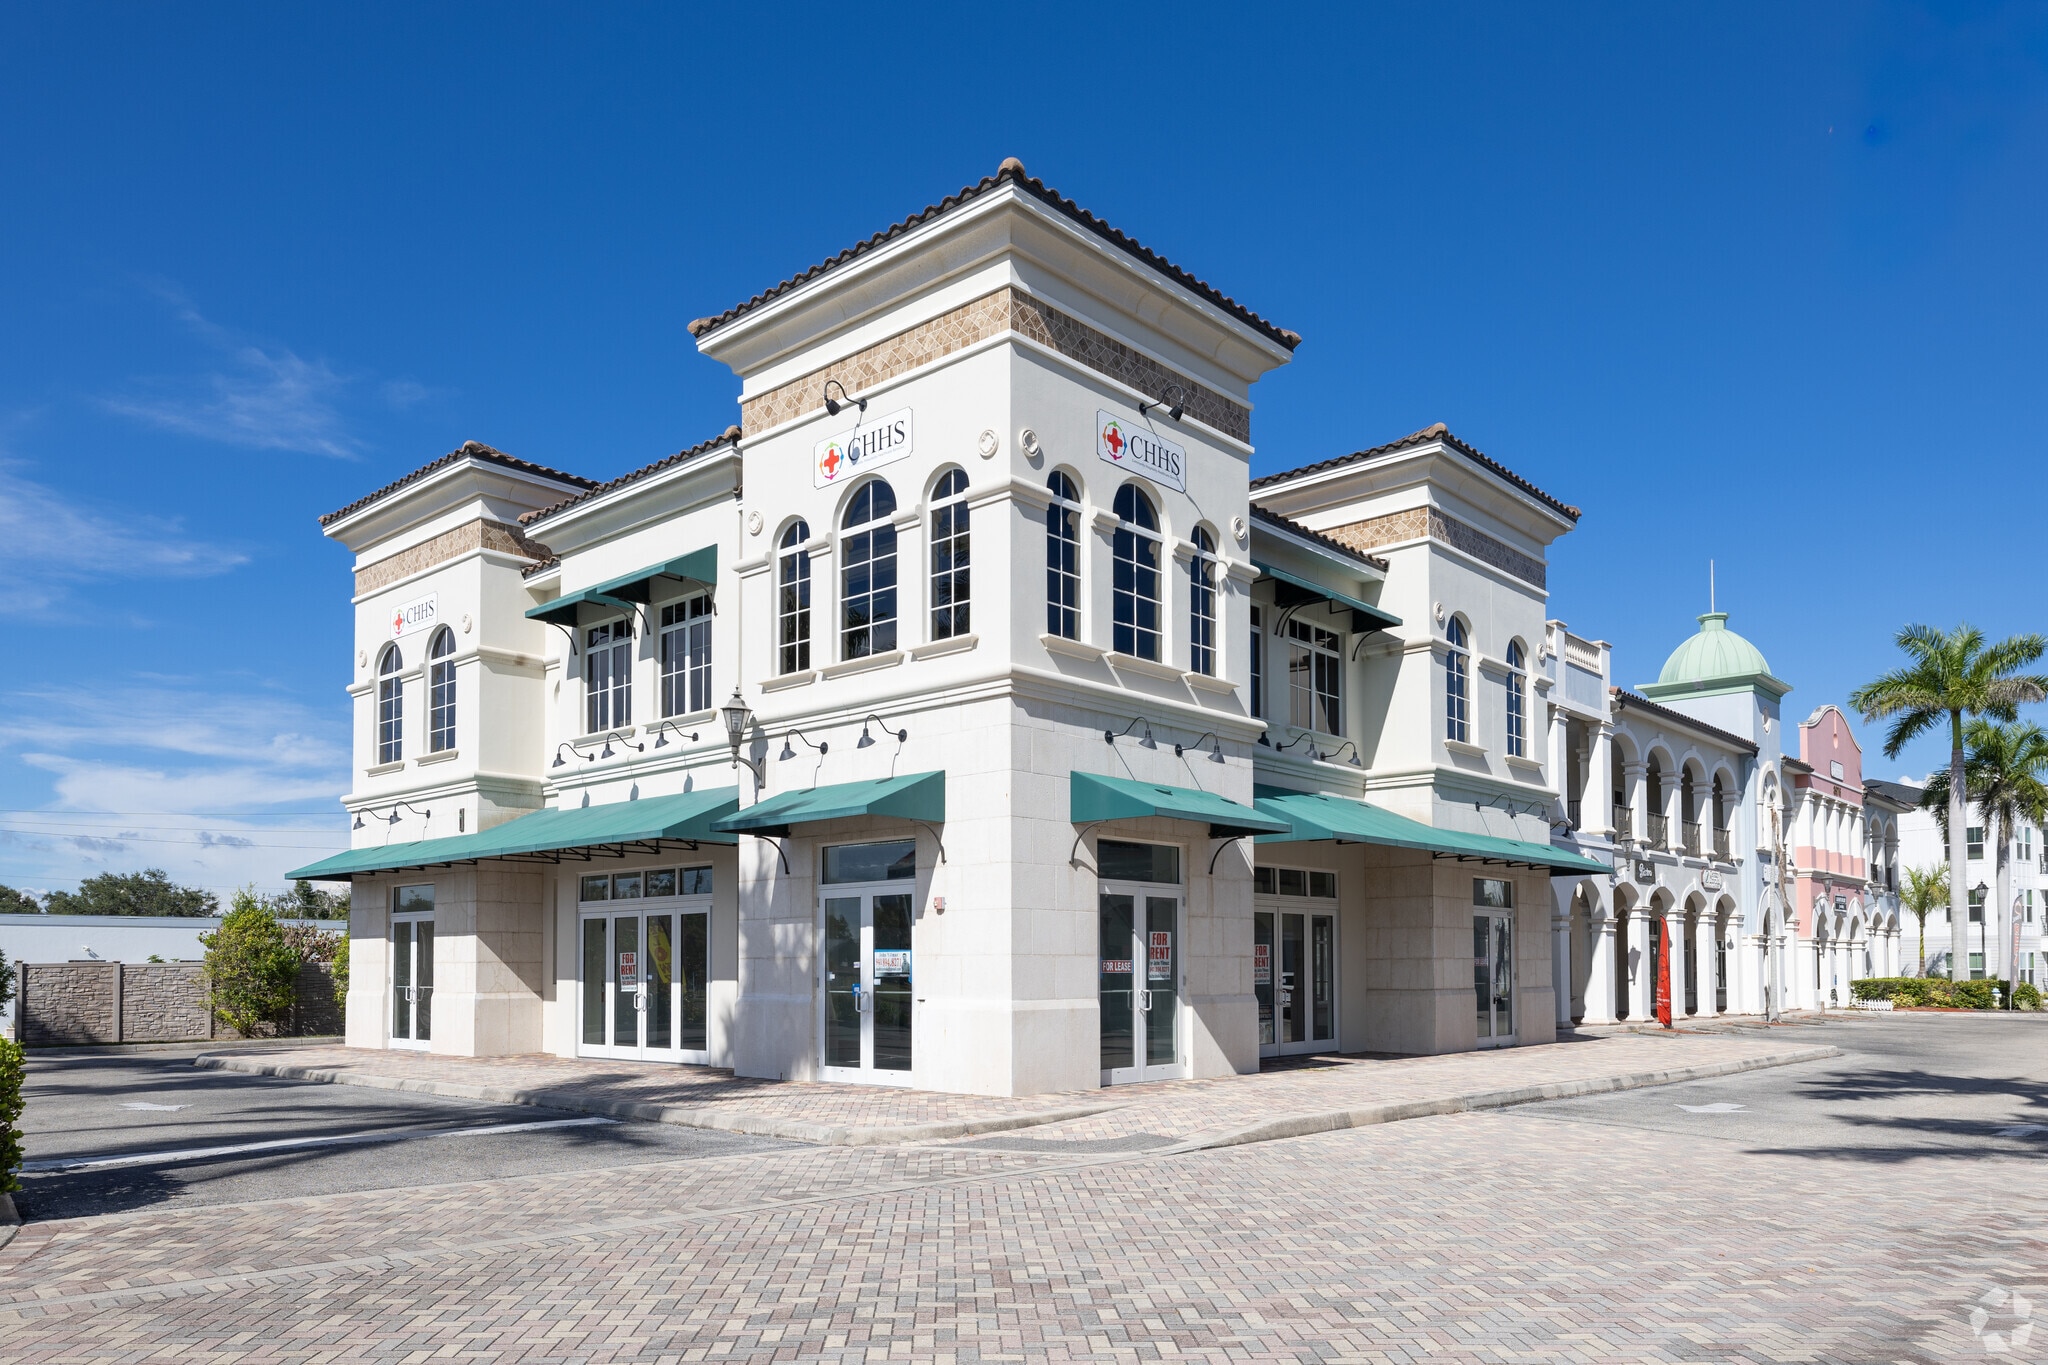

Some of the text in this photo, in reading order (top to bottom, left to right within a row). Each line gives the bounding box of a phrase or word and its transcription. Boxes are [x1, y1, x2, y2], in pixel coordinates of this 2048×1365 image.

[848, 420, 905, 461] CHHS
[1130, 435, 1180, 476] CHHS
[406, 600, 435, 624] CHHS
[1152, 933, 1167, 946] FOR
[1150, 947, 1170, 960] RENT
[1255, 946, 1267, 956] FOR
[622, 954, 634, 964] FOR
[1254, 957, 1269, 967] RENT
[621, 965, 636, 975] RENT
[1103, 962, 1131, 971] FOR LEASE
